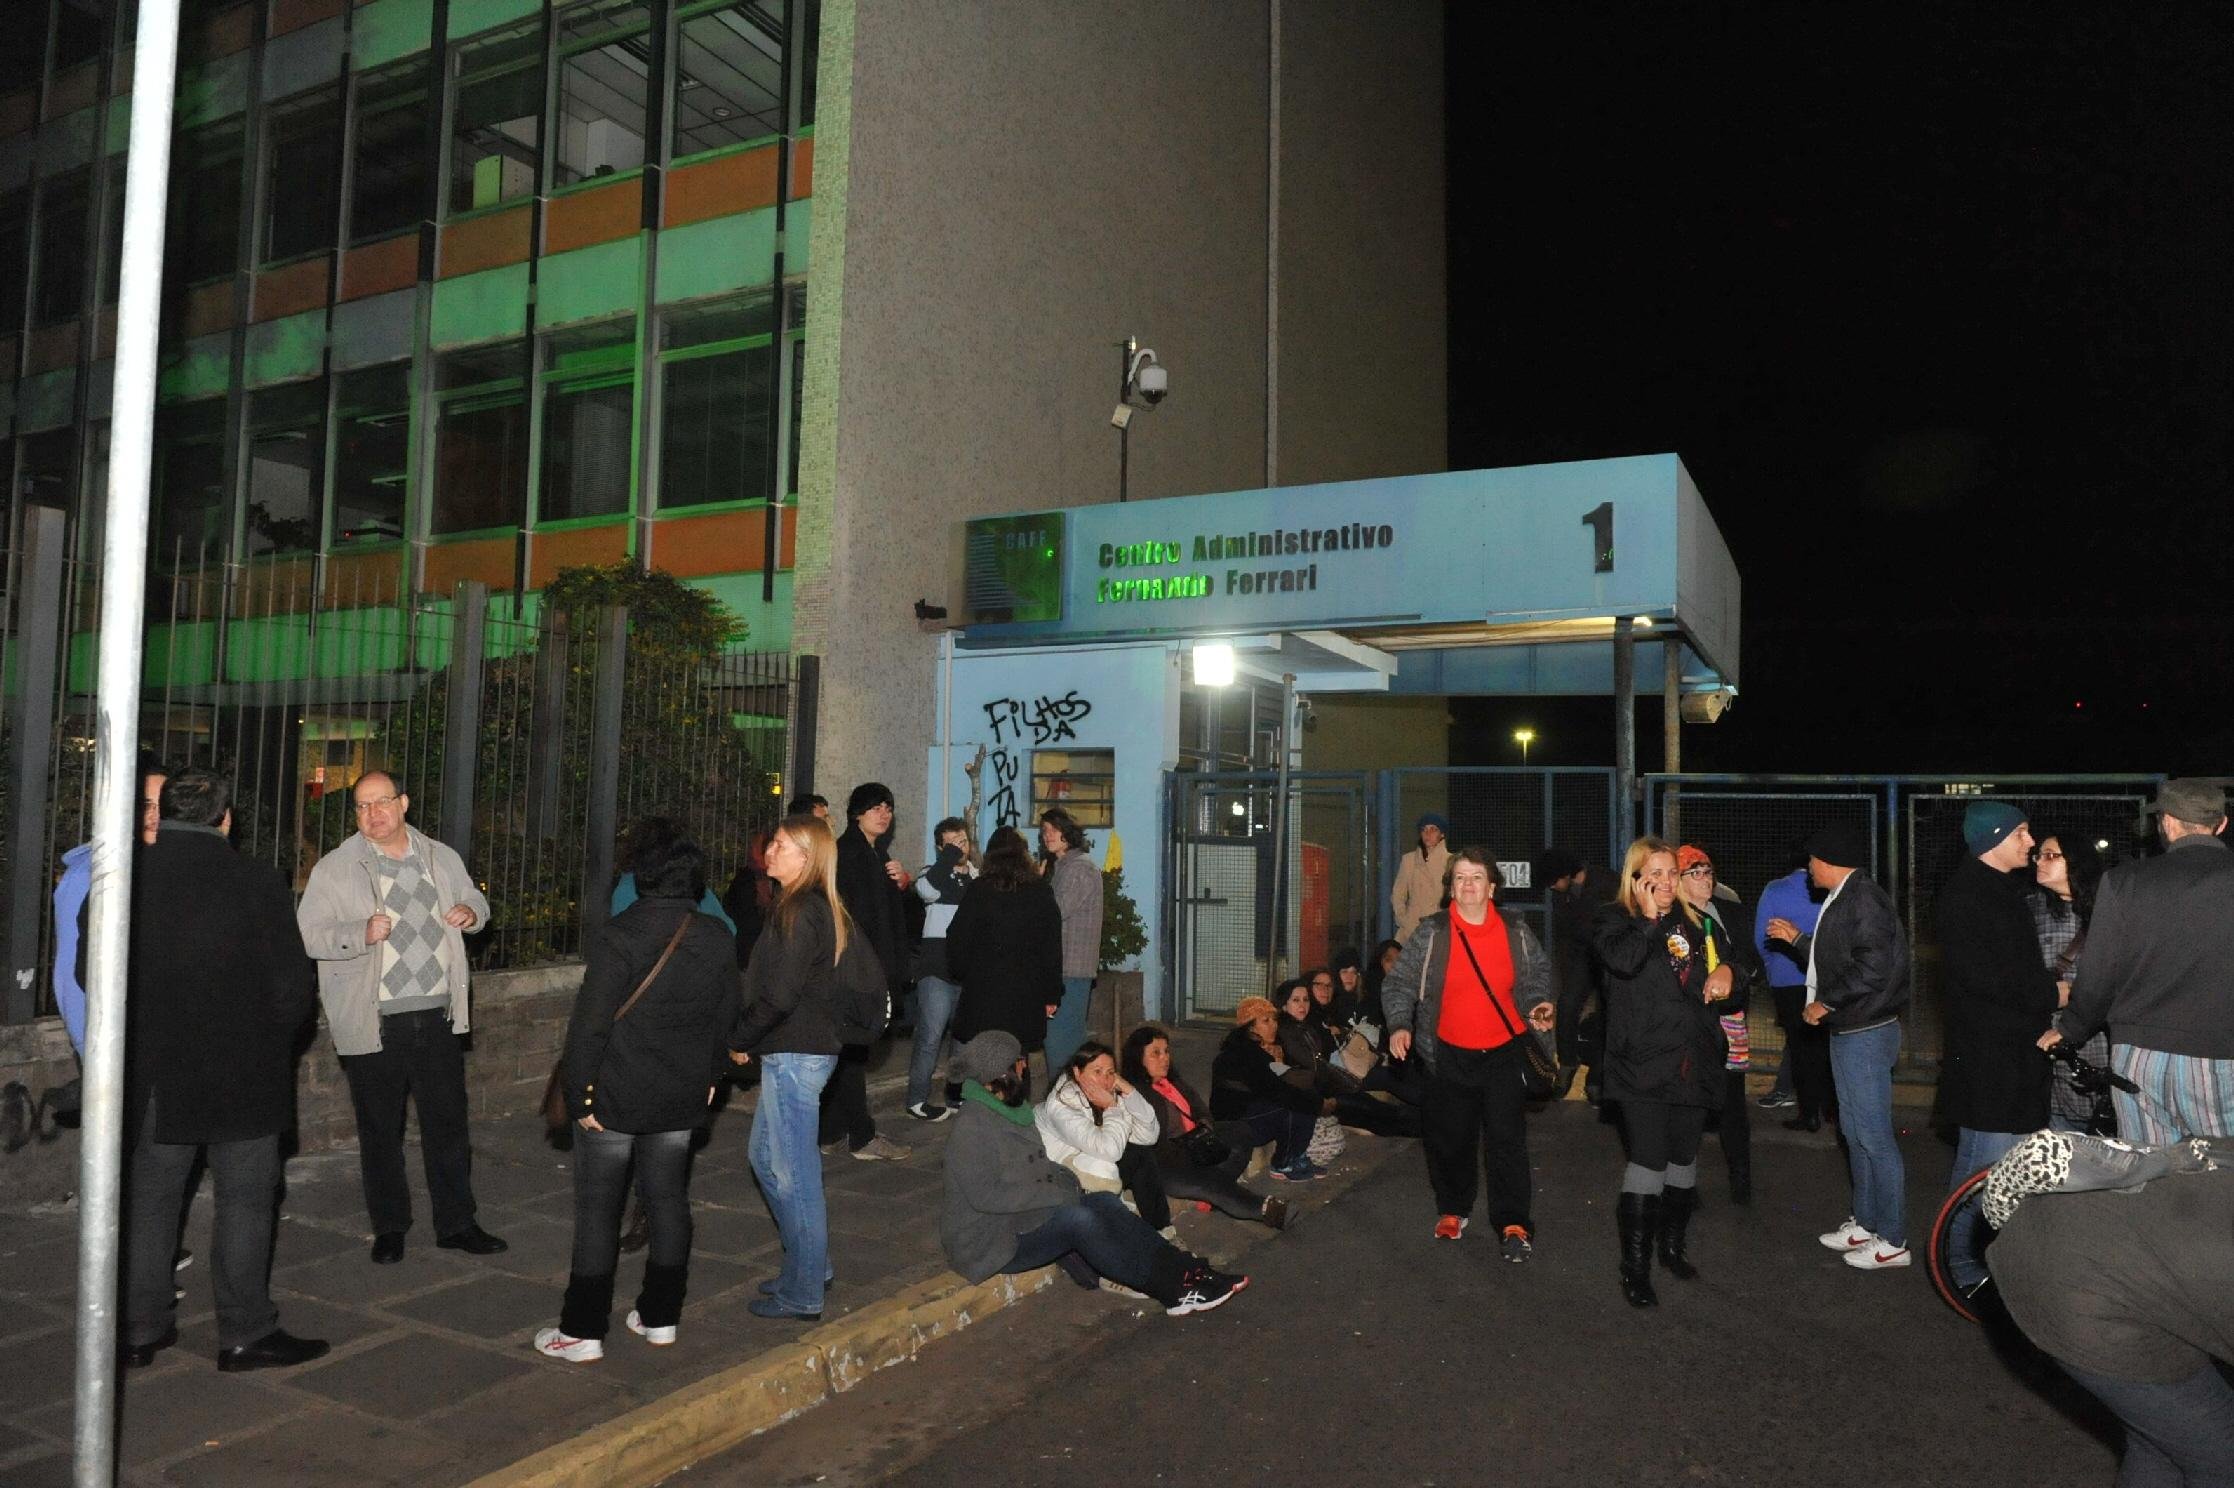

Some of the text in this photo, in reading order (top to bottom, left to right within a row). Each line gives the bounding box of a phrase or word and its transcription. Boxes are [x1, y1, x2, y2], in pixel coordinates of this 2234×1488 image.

[1098, 522, 1394, 568] Centro Administrativo
[1582, 501, 1614, 574] 1
[1096, 564, 1317, 604] Fernando Ferrari
[1035, 718, 1076, 745] DA
